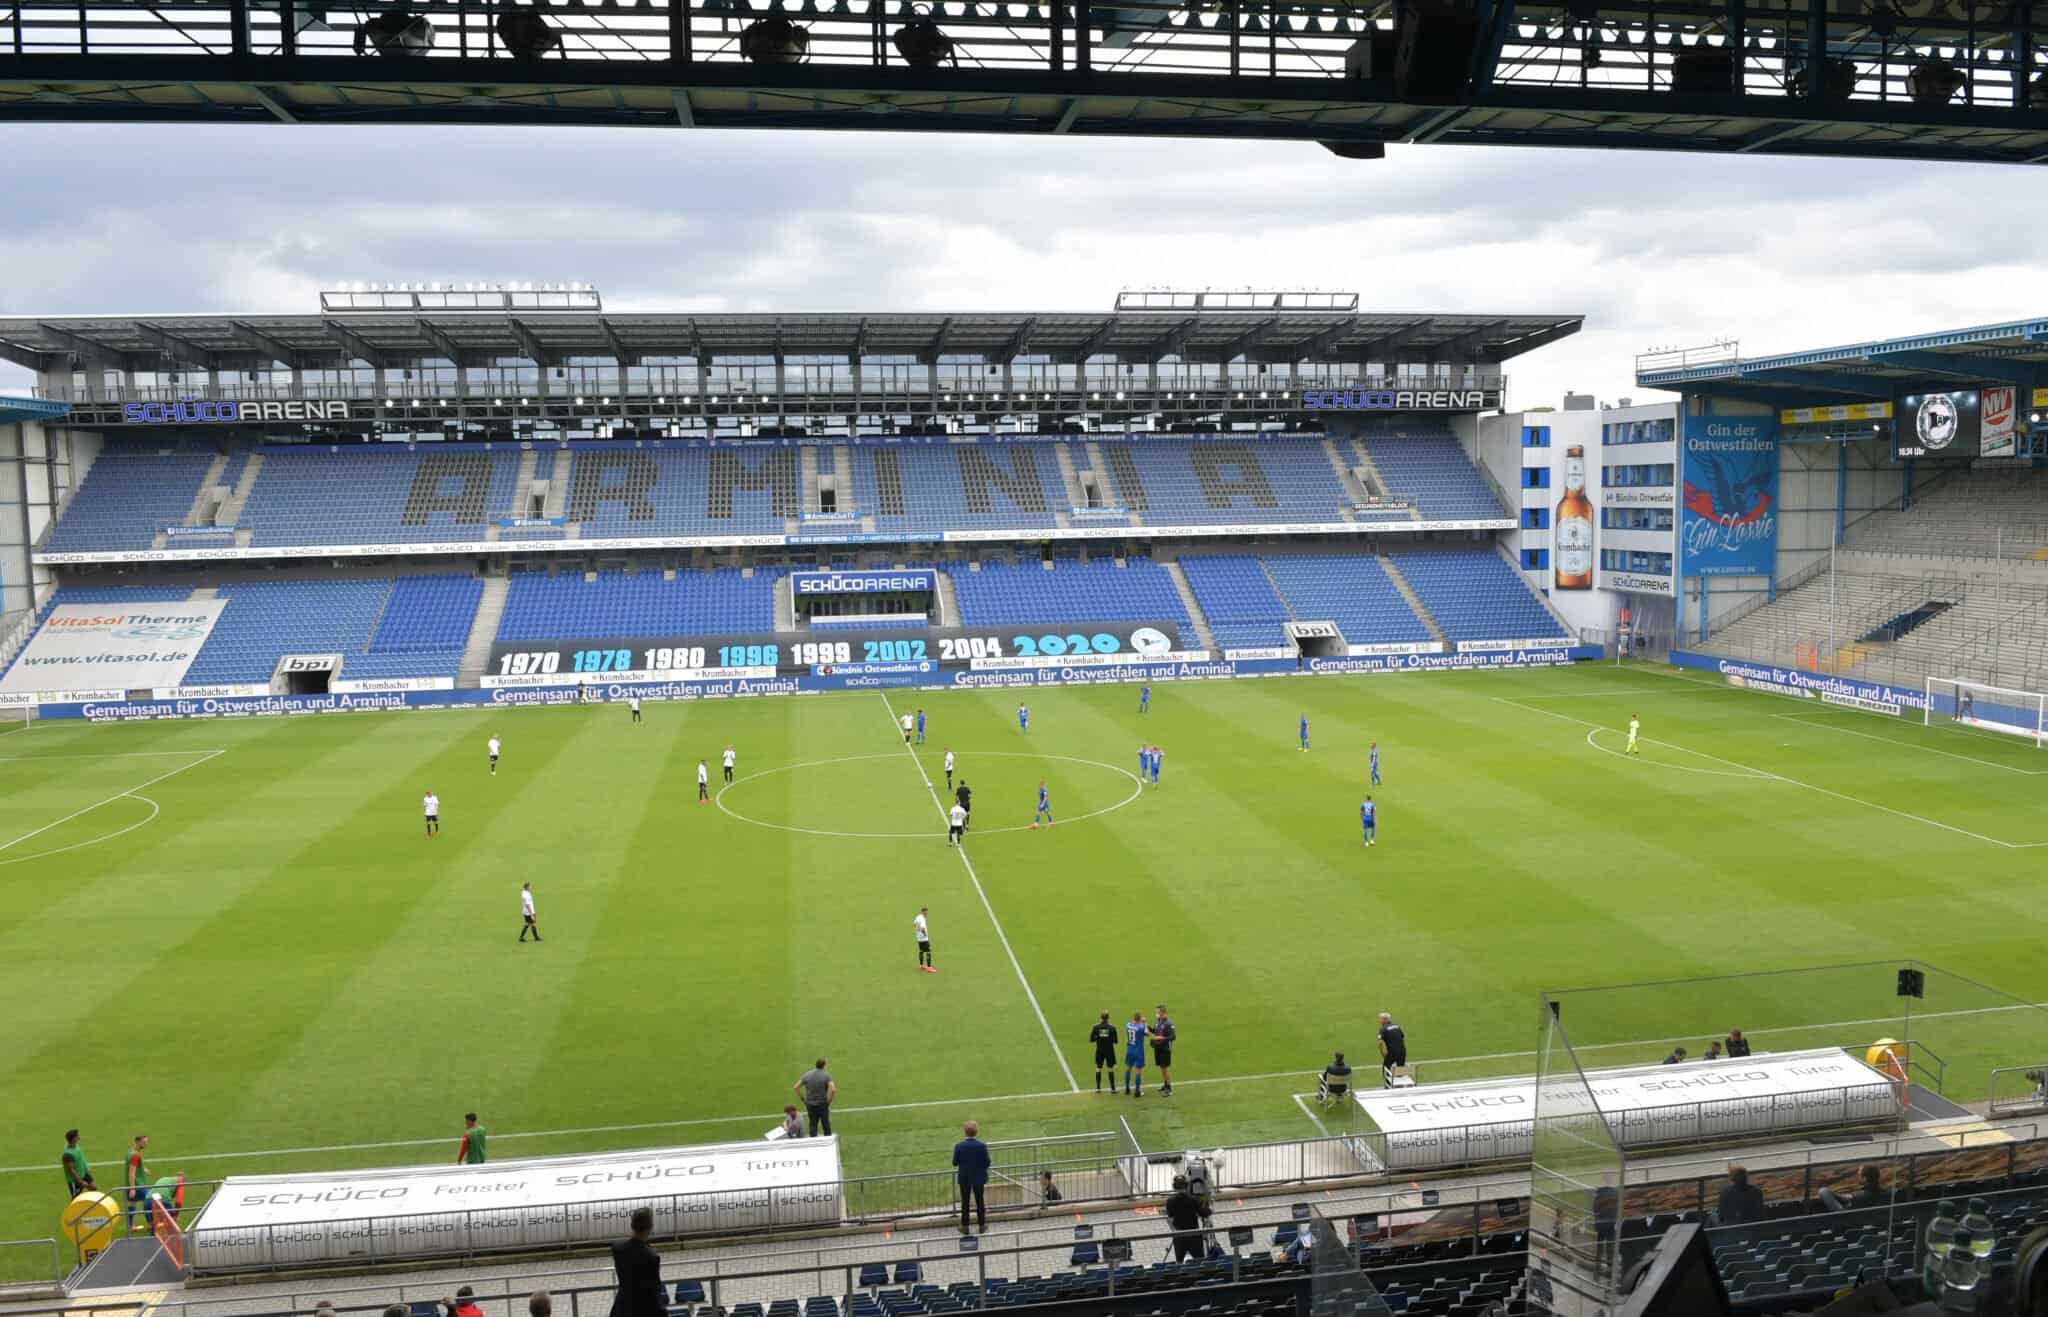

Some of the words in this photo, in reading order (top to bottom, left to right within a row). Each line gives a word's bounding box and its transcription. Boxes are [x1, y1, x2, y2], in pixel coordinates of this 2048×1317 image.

[1707, 424, 1731, 436] Gin
[1734, 424, 1758, 436] der
[1688, 438, 1775, 451] Ostwestfalen
[49, 616, 125, 626] VitaSol
[127, 615, 208, 626] Therme
[24, 651, 188, 666] www.vitasol.de
[501, 652, 560, 675] 1970
[573, 649, 632, 672] 1978
[644, 647, 705, 670] 1980
[719, 645, 778, 667] 1996
[791, 642, 851, 664] 1999
[863, 640, 928, 662] 2002
[938, 637, 1002, 659] 2004
[1013, 633, 1120, 656] 2020
[1063, 656, 1105, 665] Krombacher
[1310, 658, 1383, 671] Gemeinsam
[1387, 655, 1404, 668] für
[1407, 653, 1487, 667] Ostwestfalen
[1491, 652, 1513, 664] und
[1517, 649, 1568, 663] Arminia!
[864, 663, 917, 673] Ostwestfalen
[983, 658, 1025, 667] Krombacher
[599, 673, 645, 682] Krombacher
[702, 669, 747, 677] Krombacher
[955, 671, 1034, 685] Gemeinsam
[1038, 667, 1058, 681] für
[1061, 665, 1147, 680] Ostwestfalen
[1151, 664, 1175, 676] und
[1179, 662, 1235, 676] Arminia!
[362, 680, 409, 690] Krombacher
[498, 676, 544, 686] Krombacher
[1719, 660, 1771, 681] Gemeinsam
[1773, 669, 1787, 682] für
[1789, 671, 1855, 696] Ostwestfalen
[1858, 685, 1880, 701] und
[72, 691, 120, 701] Krombacher
[178, 688, 229, 697] Krombacher
[492, 689, 579, 702] Gemeinsam
[608, 682, 701, 698] Ostwestfalen
[706, 680, 733, 694] und
[737, 678, 800, 693] Arminia!
[82, 703, 172, 718] Gemeinsam
[176, 700, 199, 713] für
[203, 694, 306, 713] Ostwestfalen
[309, 693, 336, 709] und
[340, 690, 405, 708] Arminia!
[1388, 1095, 1525, 1115] SCHÜCO
[1640, 1071, 1770, 1092] SCHÜCO
[1391, 1138, 1439, 1149] SCHÜCO
[1497, 1128, 1534, 1141] SCHÜC
[1703, 1108, 1746, 1120] SCHÜCO
[240, 1186, 409, 1207] SCHÜCO
[434, 1180, 528, 1195] Fenster
[555, 1164, 714, 1186] SCHÜCO
[743, 1158, 809, 1172] Türen
[200, 1236, 256, 1249] SCHÜCO
[331, 1227, 388, 1240] SCHÜCO
[399, 1222, 454, 1236] SCHÜCO
[464, 1217, 518, 1231] SCHÜCO
[528, 1212, 583, 1225] SCHÜCO
[656, 1203, 709, 1216] SCHÜCO
[718, 1198, 770, 1211] SCHÜCO
[781, 1193, 833, 1206] SCHÜCO
